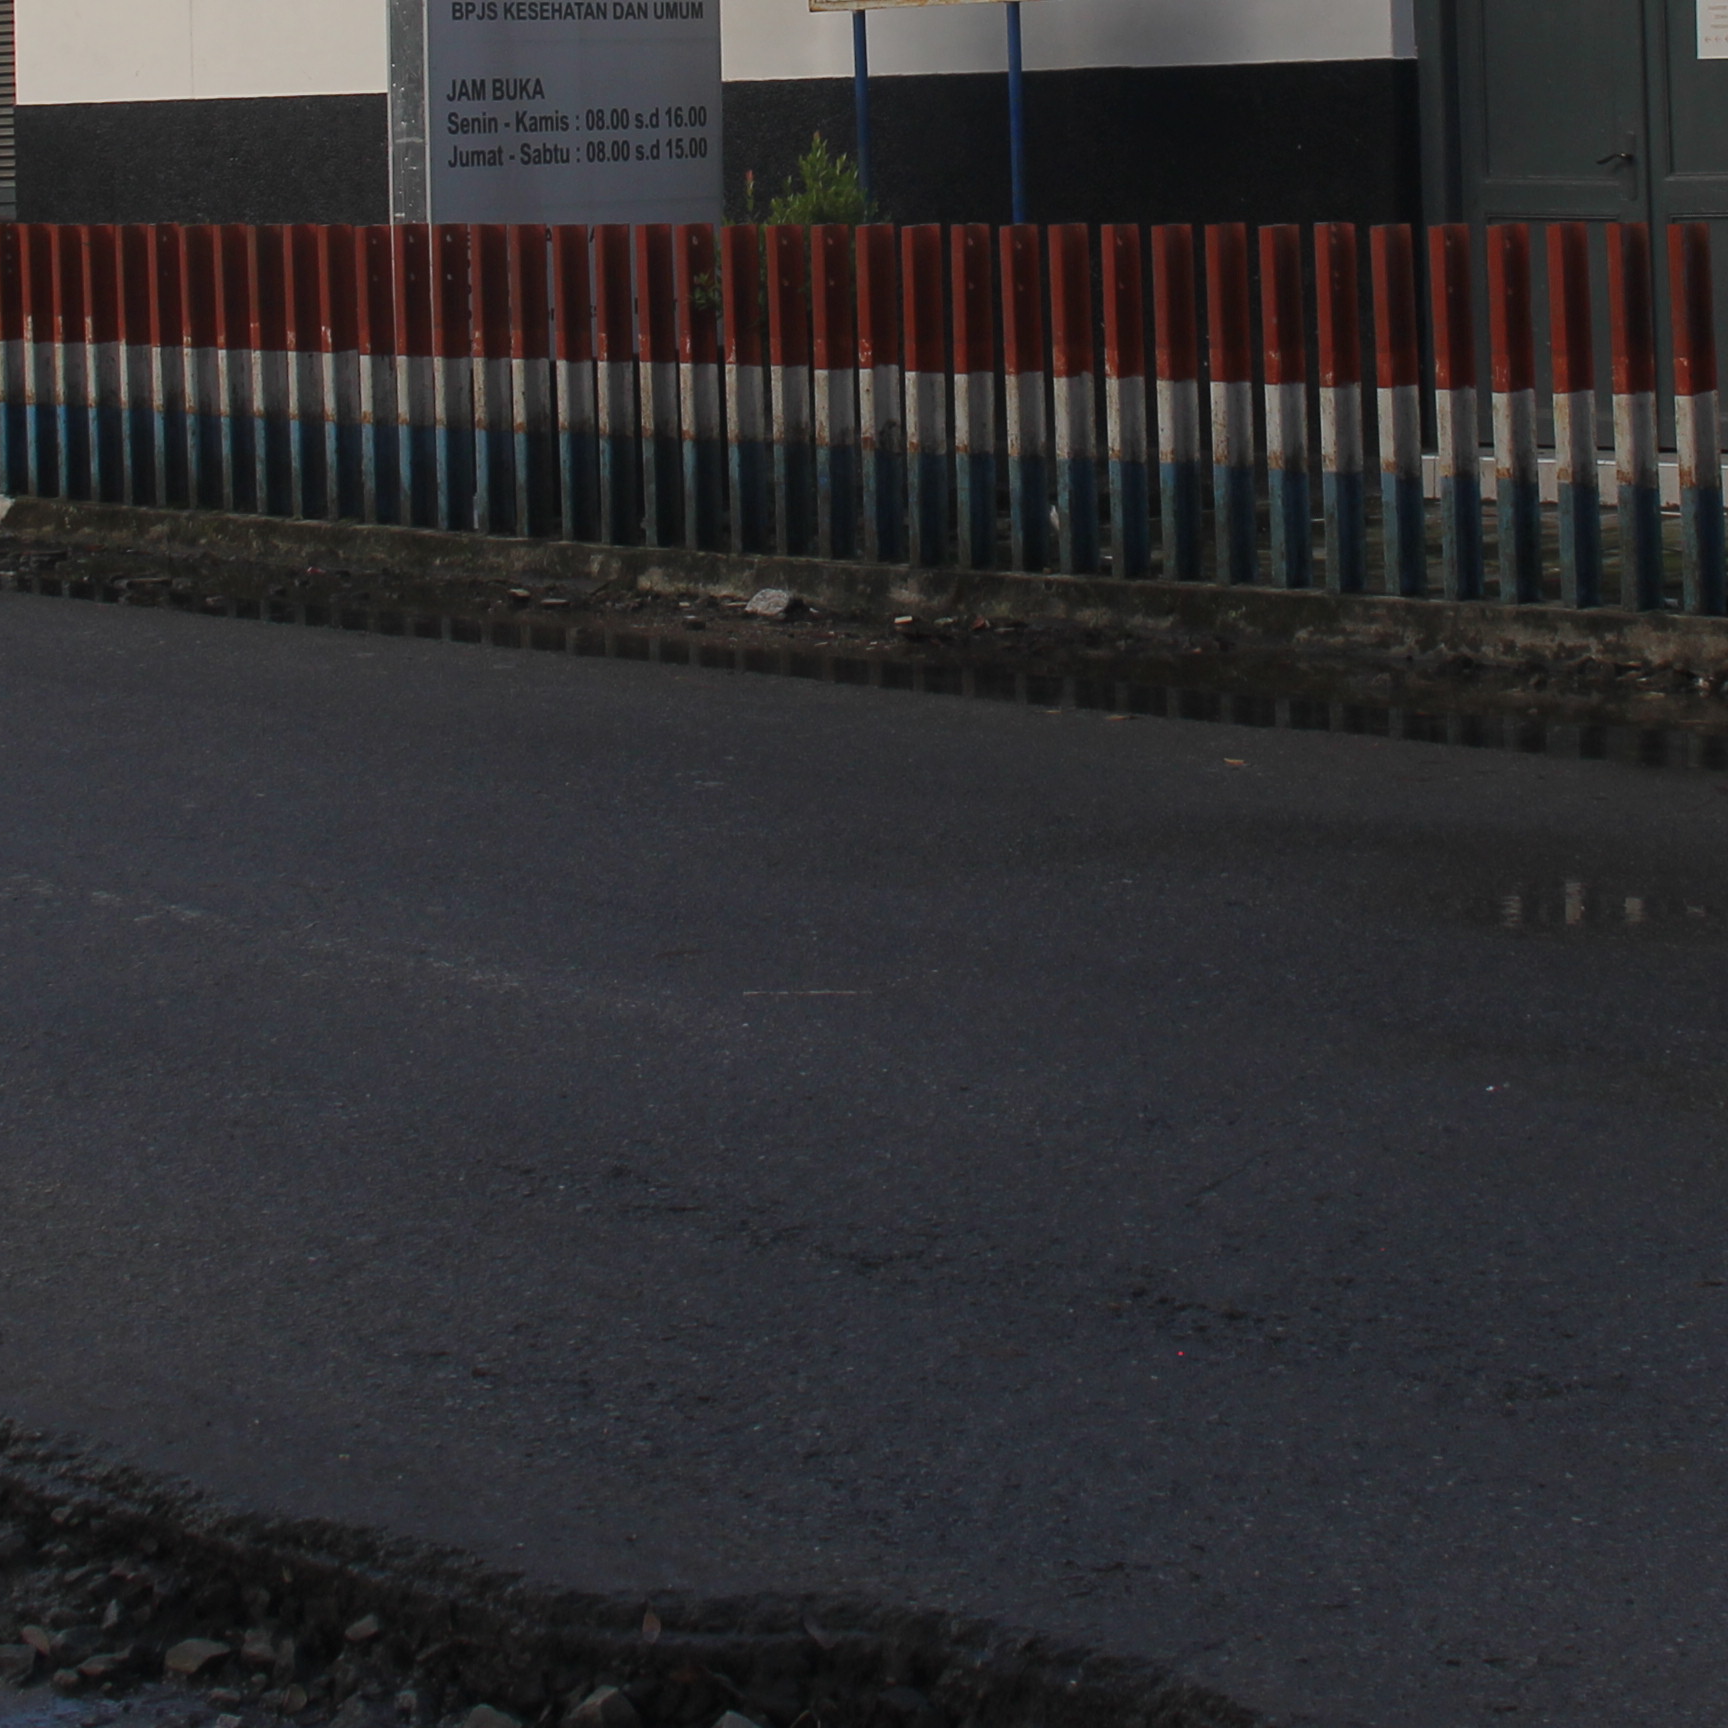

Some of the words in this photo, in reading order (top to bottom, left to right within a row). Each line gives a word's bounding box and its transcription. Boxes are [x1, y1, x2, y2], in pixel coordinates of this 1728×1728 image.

[452, 1, 498, 21] BPJS
[504, 1, 608, 21] KESEHATAN
[613, 1, 648, 20] DAN
[653, 1, 704, 20] UMUM
[446, 78, 486, 102] JAM
[492, 78, 545, 101] BUKA
[447, 112, 498, 135] Senin
[515, 110, 570, 133] Kamis
[585, 108, 630, 131] 08.00
[635, 107, 660, 129] s.d
[665, 105, 707, 128] 16.00
[447, 145, 504, 168] Jumat
[520, 142, 570, 166] Sabtu
[586, 140, 630, 163] 08.00
[635, 139, 660, 161] s.d
[665, 137, 708, 160] 15.00
